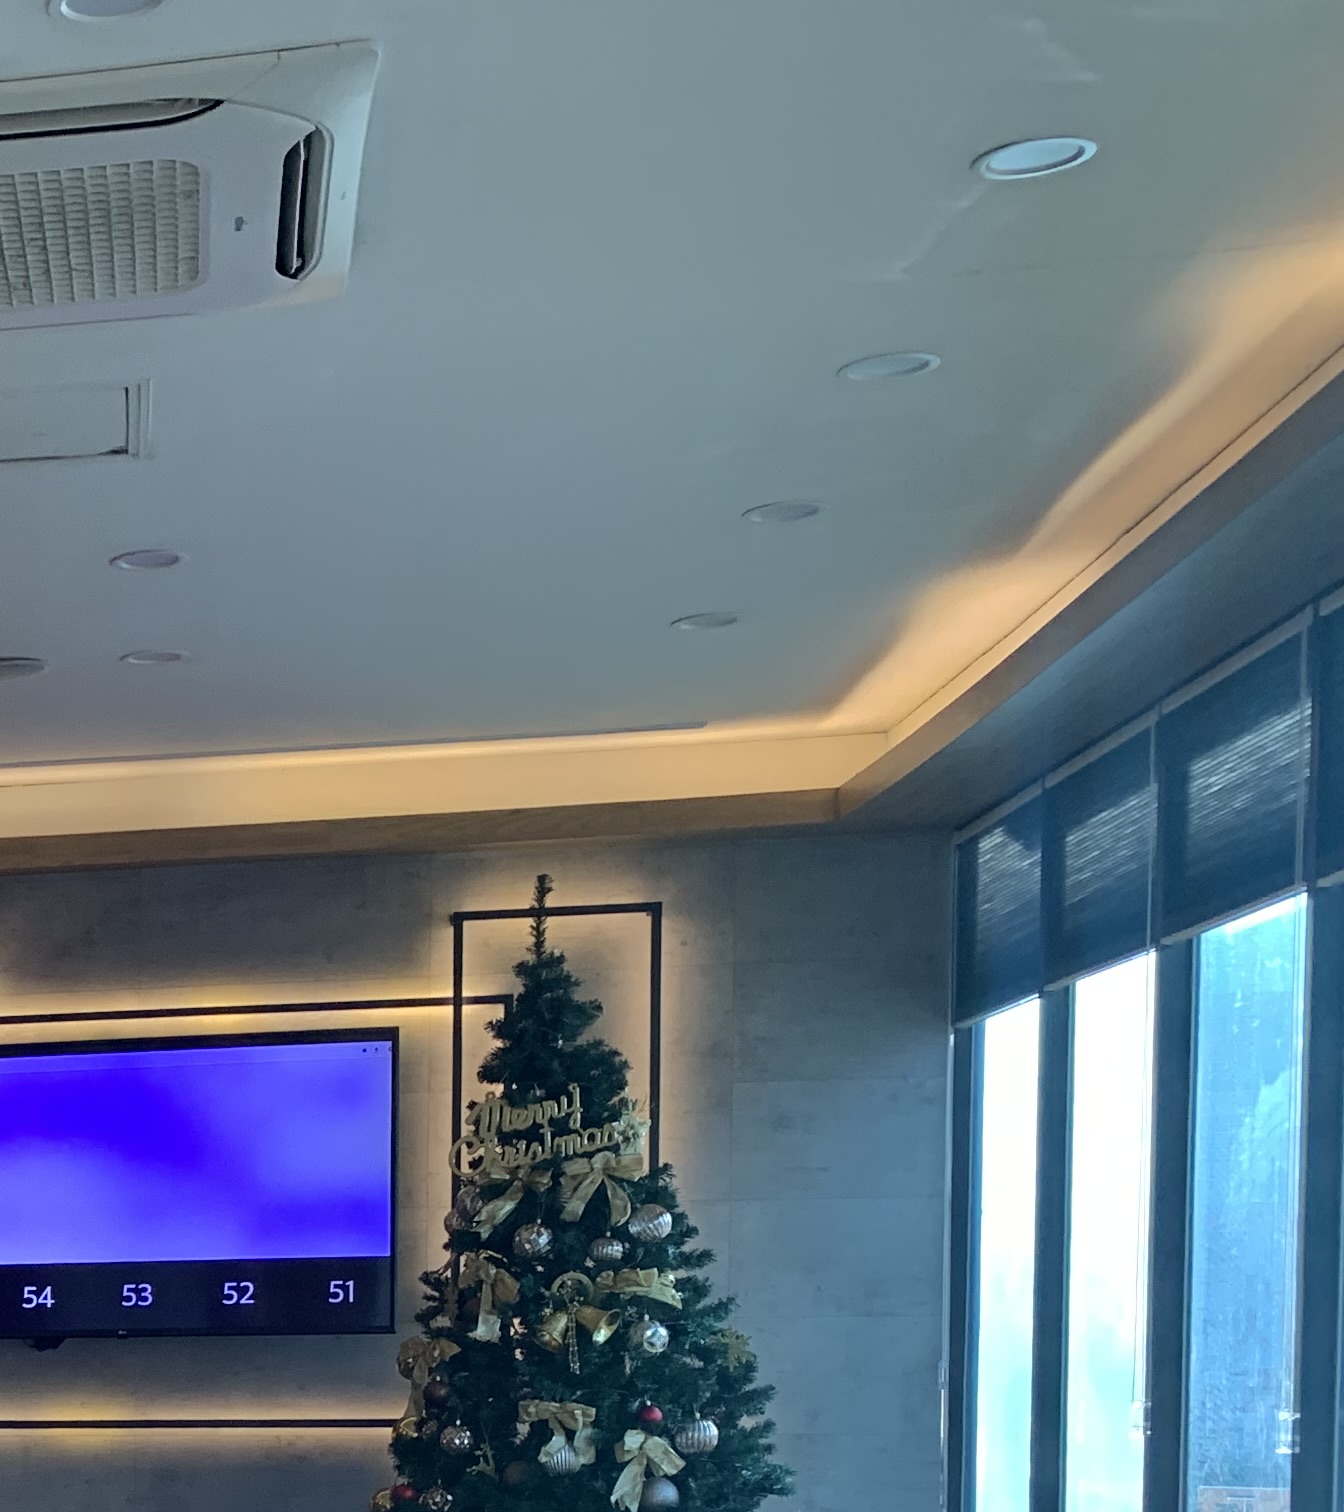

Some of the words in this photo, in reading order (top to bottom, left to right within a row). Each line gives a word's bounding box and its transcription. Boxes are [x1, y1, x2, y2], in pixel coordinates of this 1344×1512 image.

[465, 1082, 583, 1138] Merry
[22, 1286, 55, 1309] 54
[121, 1284, 153, 1306] 53
[222, 1282, 255, 1305] 52
[328, 1280, 355, 1303] 51
